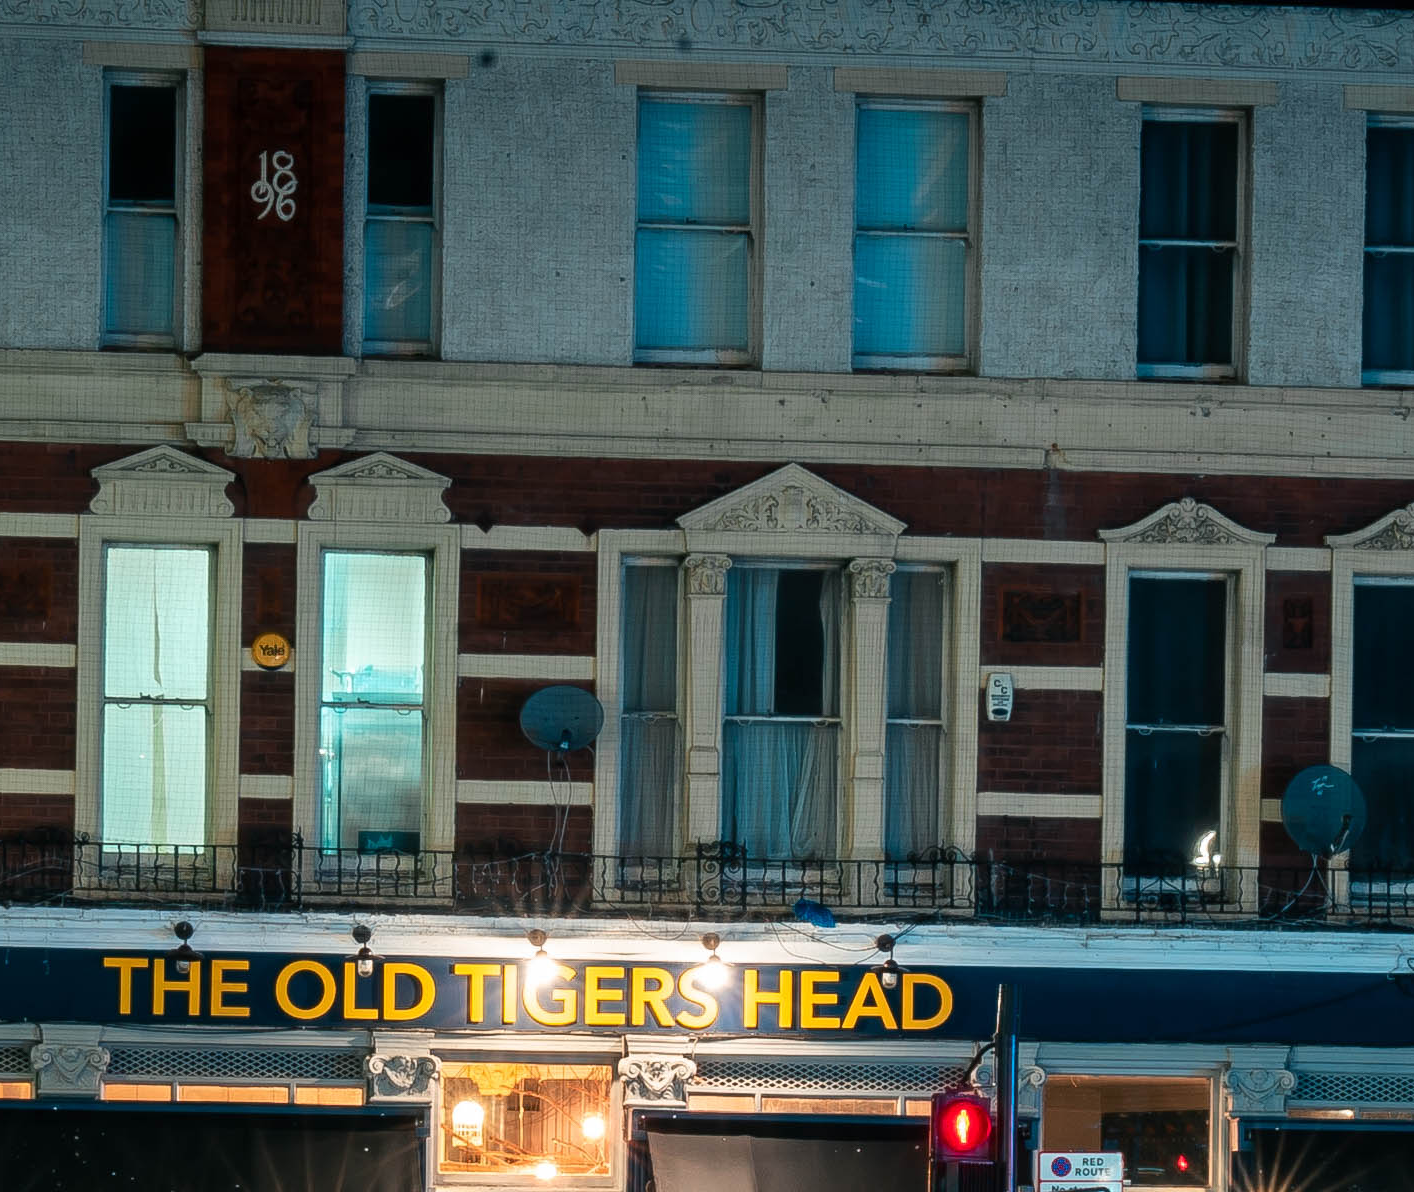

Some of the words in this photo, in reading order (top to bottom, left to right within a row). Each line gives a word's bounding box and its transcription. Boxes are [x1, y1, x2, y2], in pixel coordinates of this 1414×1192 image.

[259, 644, 285, 657] Yale
[104, 957, 251, 1017] THE
[275, 960, 436, 1020] OLD
[454, 963, 719, 1028] TIGERS
[743, 970, 953, 1030] HEAD
[1082, 1157, 1104, 1166] RED
[1075, 1167, 1111, 1177] ROUTE
